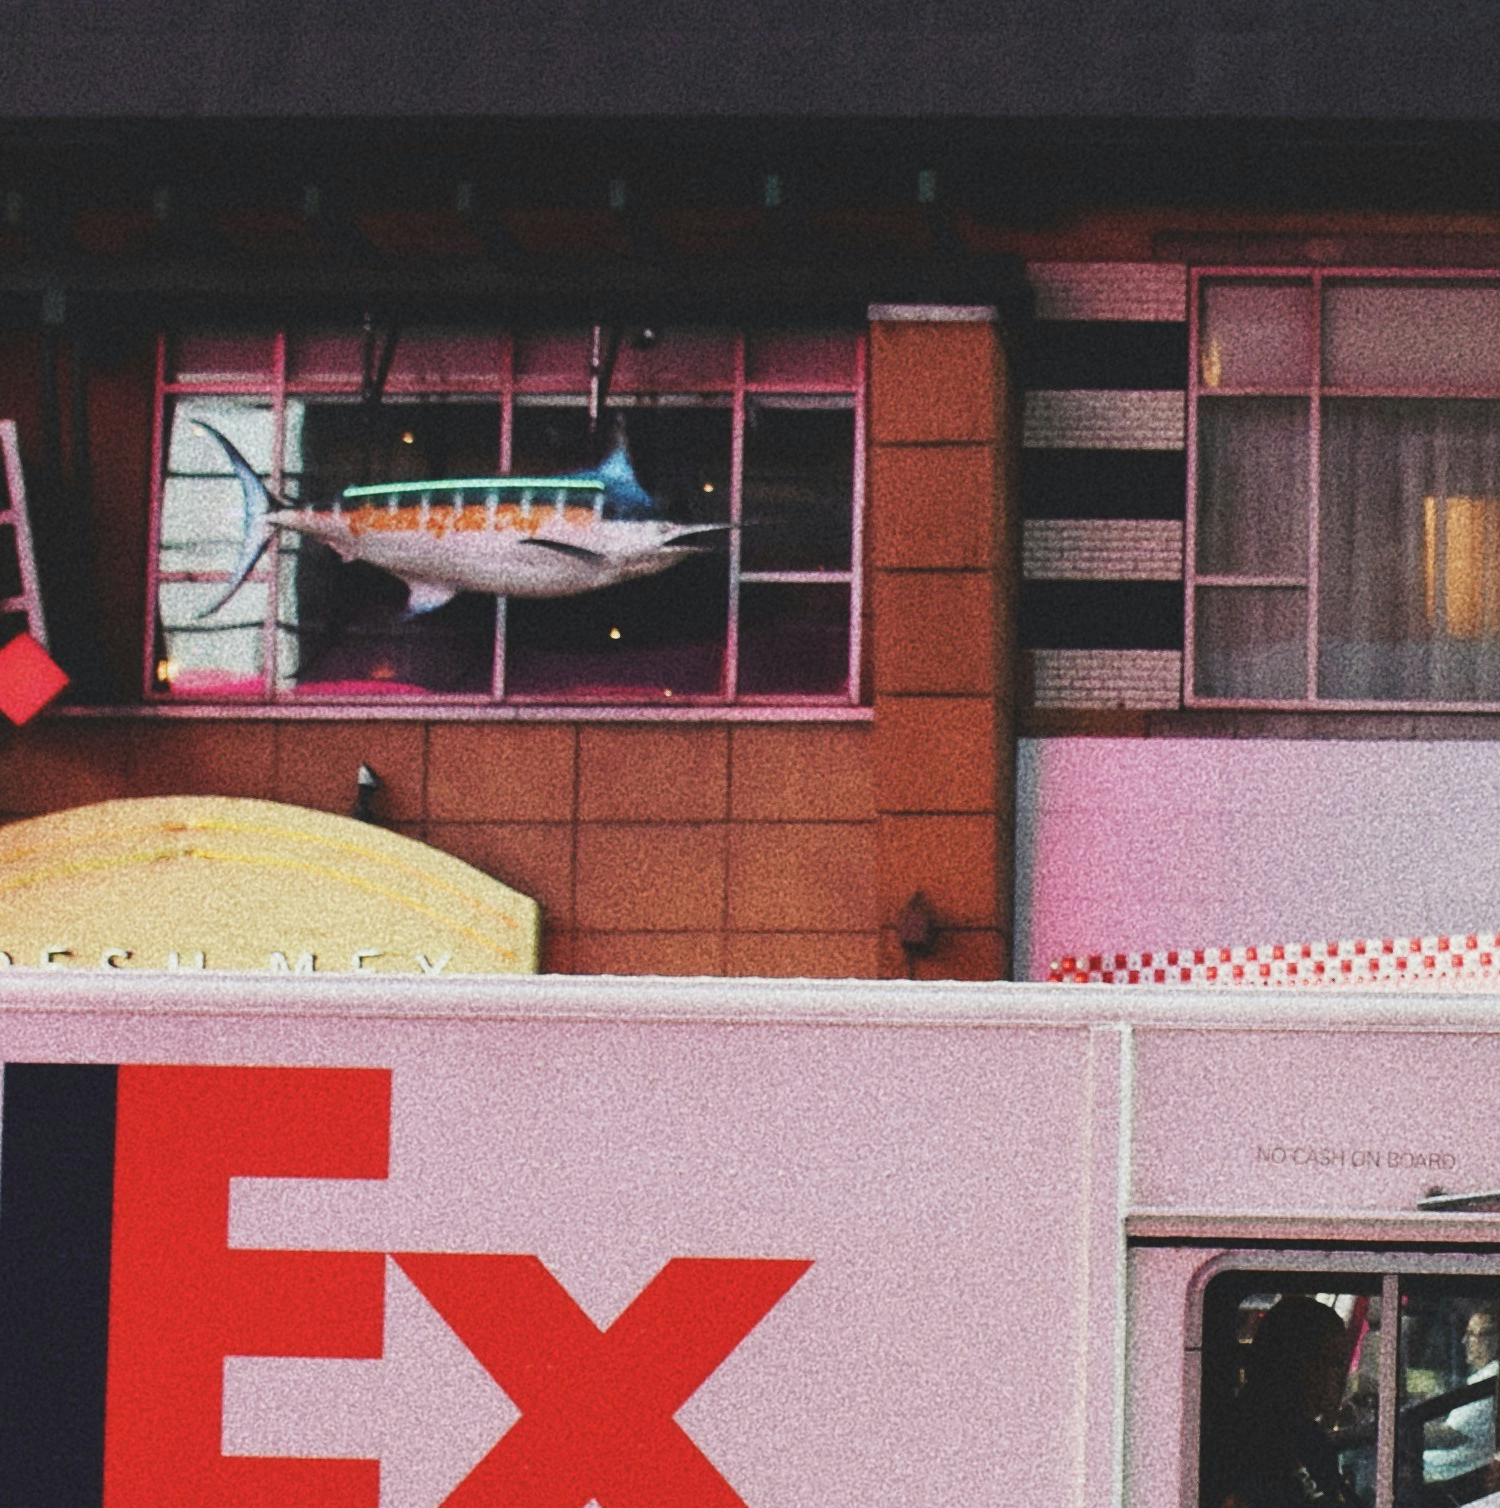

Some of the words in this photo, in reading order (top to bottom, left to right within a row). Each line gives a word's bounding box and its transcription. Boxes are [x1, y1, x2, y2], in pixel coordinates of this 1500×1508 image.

[1256, 1146, 1287, 1165] NO
[1292, 1147, 1345, 1167] CASH
[1387, 1151, 1456, 1171] BOARD
